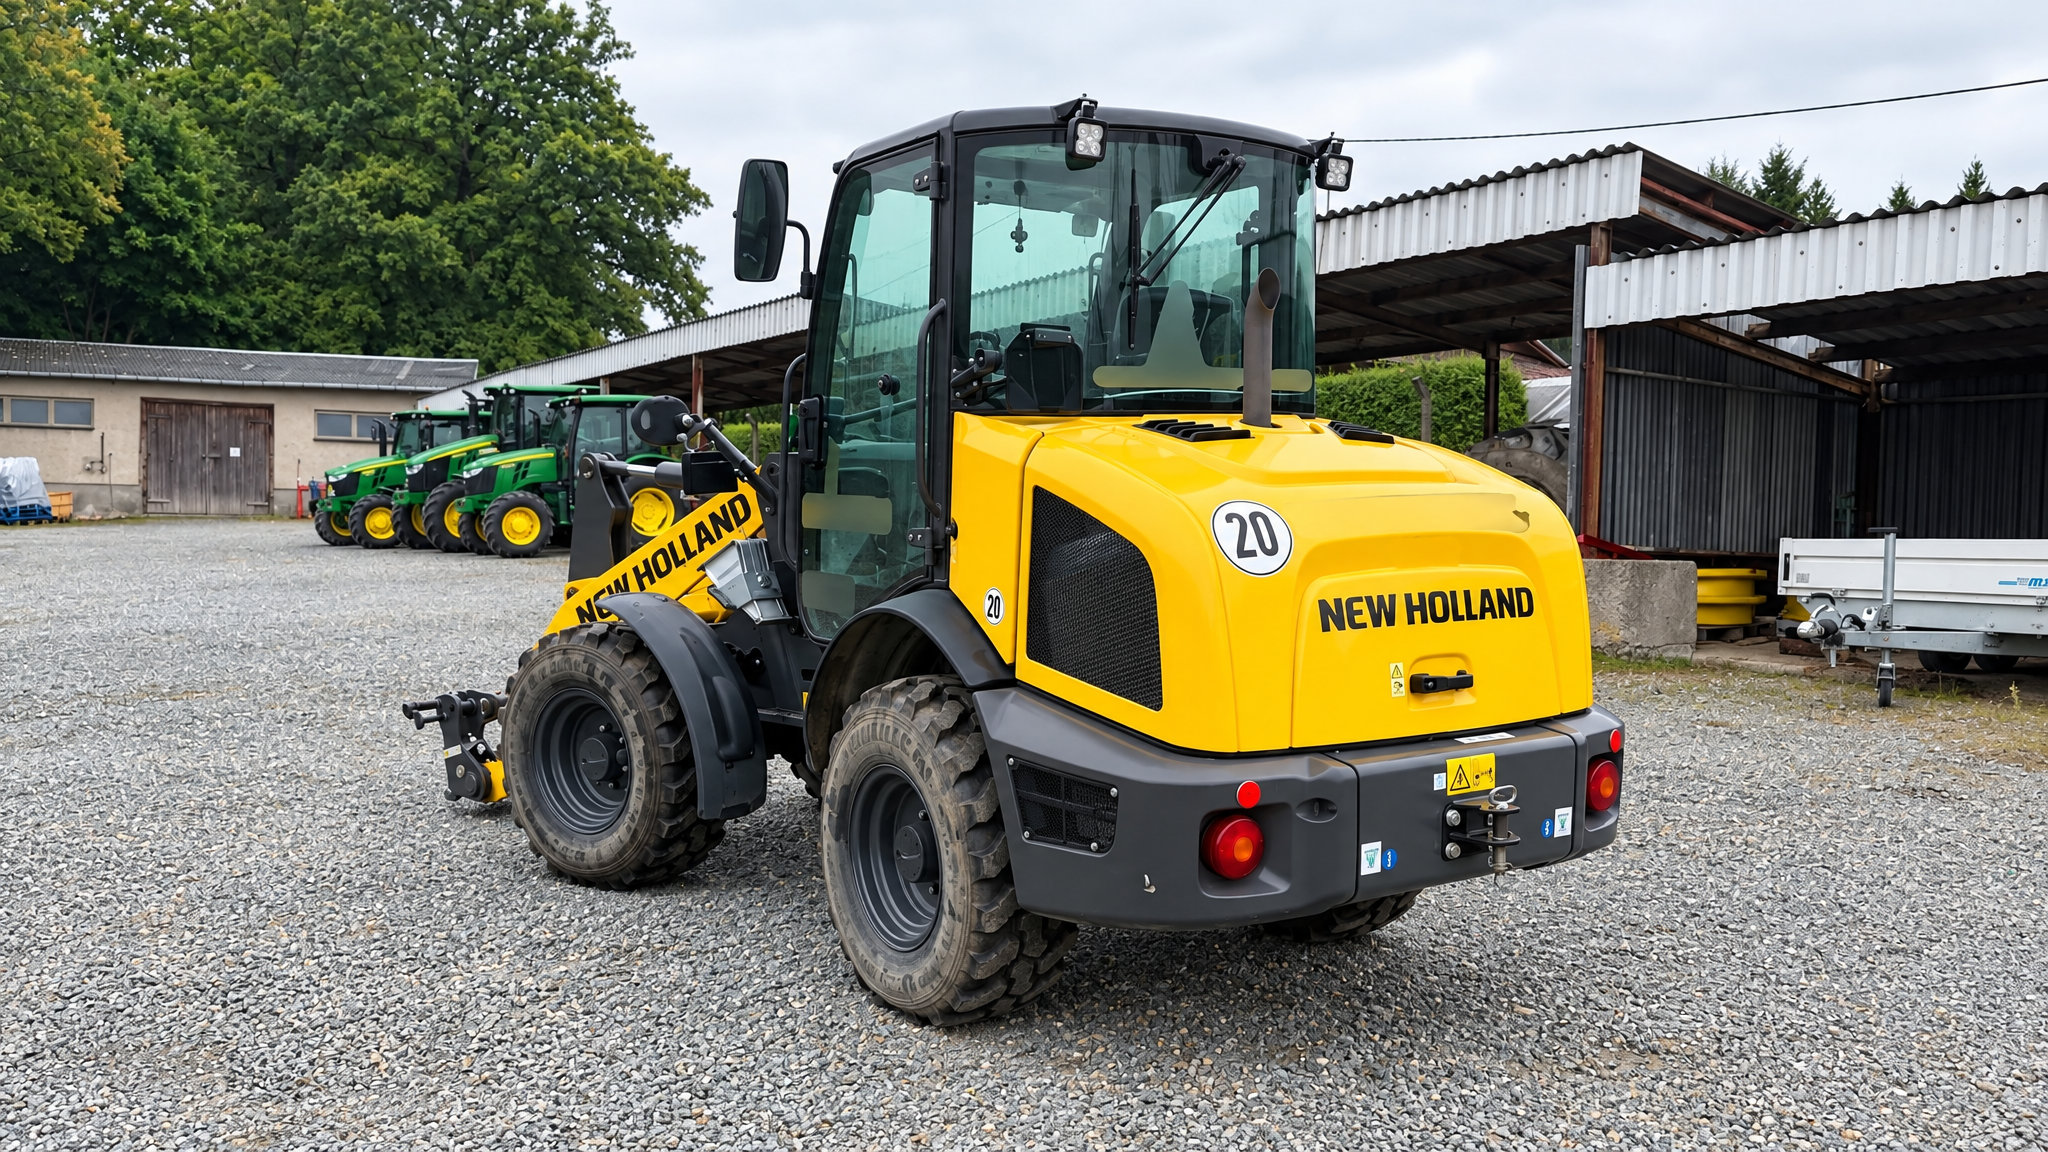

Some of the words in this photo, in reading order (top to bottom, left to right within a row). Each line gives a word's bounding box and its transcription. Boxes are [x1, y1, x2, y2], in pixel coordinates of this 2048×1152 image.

[632, 493, 752, 592] HOLLAND
[1225, 511, 1279, 559] 20
[987, 594, 1001, 619] 20
[1318, 594, 1397, 632] NEW
[1404, 587, 1535, 625] HOLLAND
